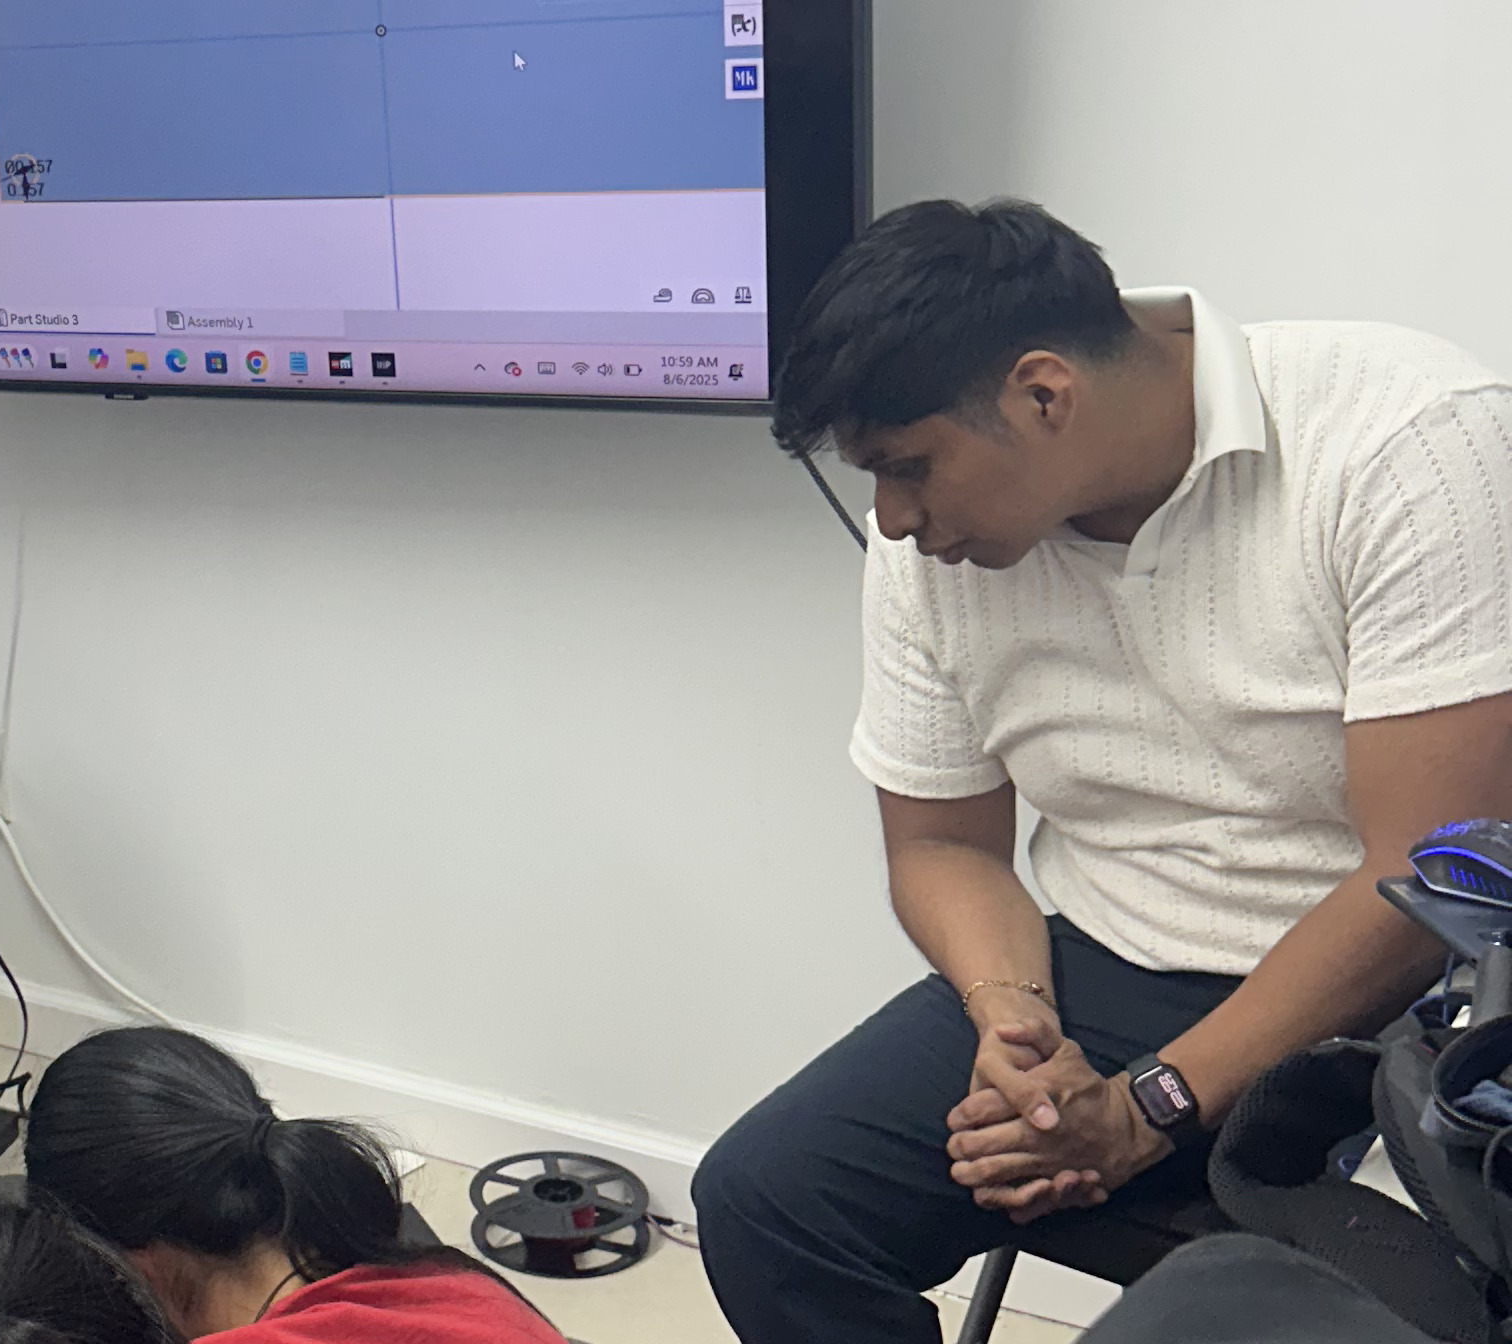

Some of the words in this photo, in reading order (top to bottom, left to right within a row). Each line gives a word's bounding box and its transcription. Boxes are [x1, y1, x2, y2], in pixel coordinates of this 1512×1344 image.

[10, 313, 33, 326] Part
[35, 313, 70, 326] Studio
[71, 314, 80, 326] 3
[187, 316, 245, 330] Assembly
[661, 356, 694, 368] 10:59
[697, 356, 719, 368] AM
[663, 374, 720, 387] 8/6/2025
